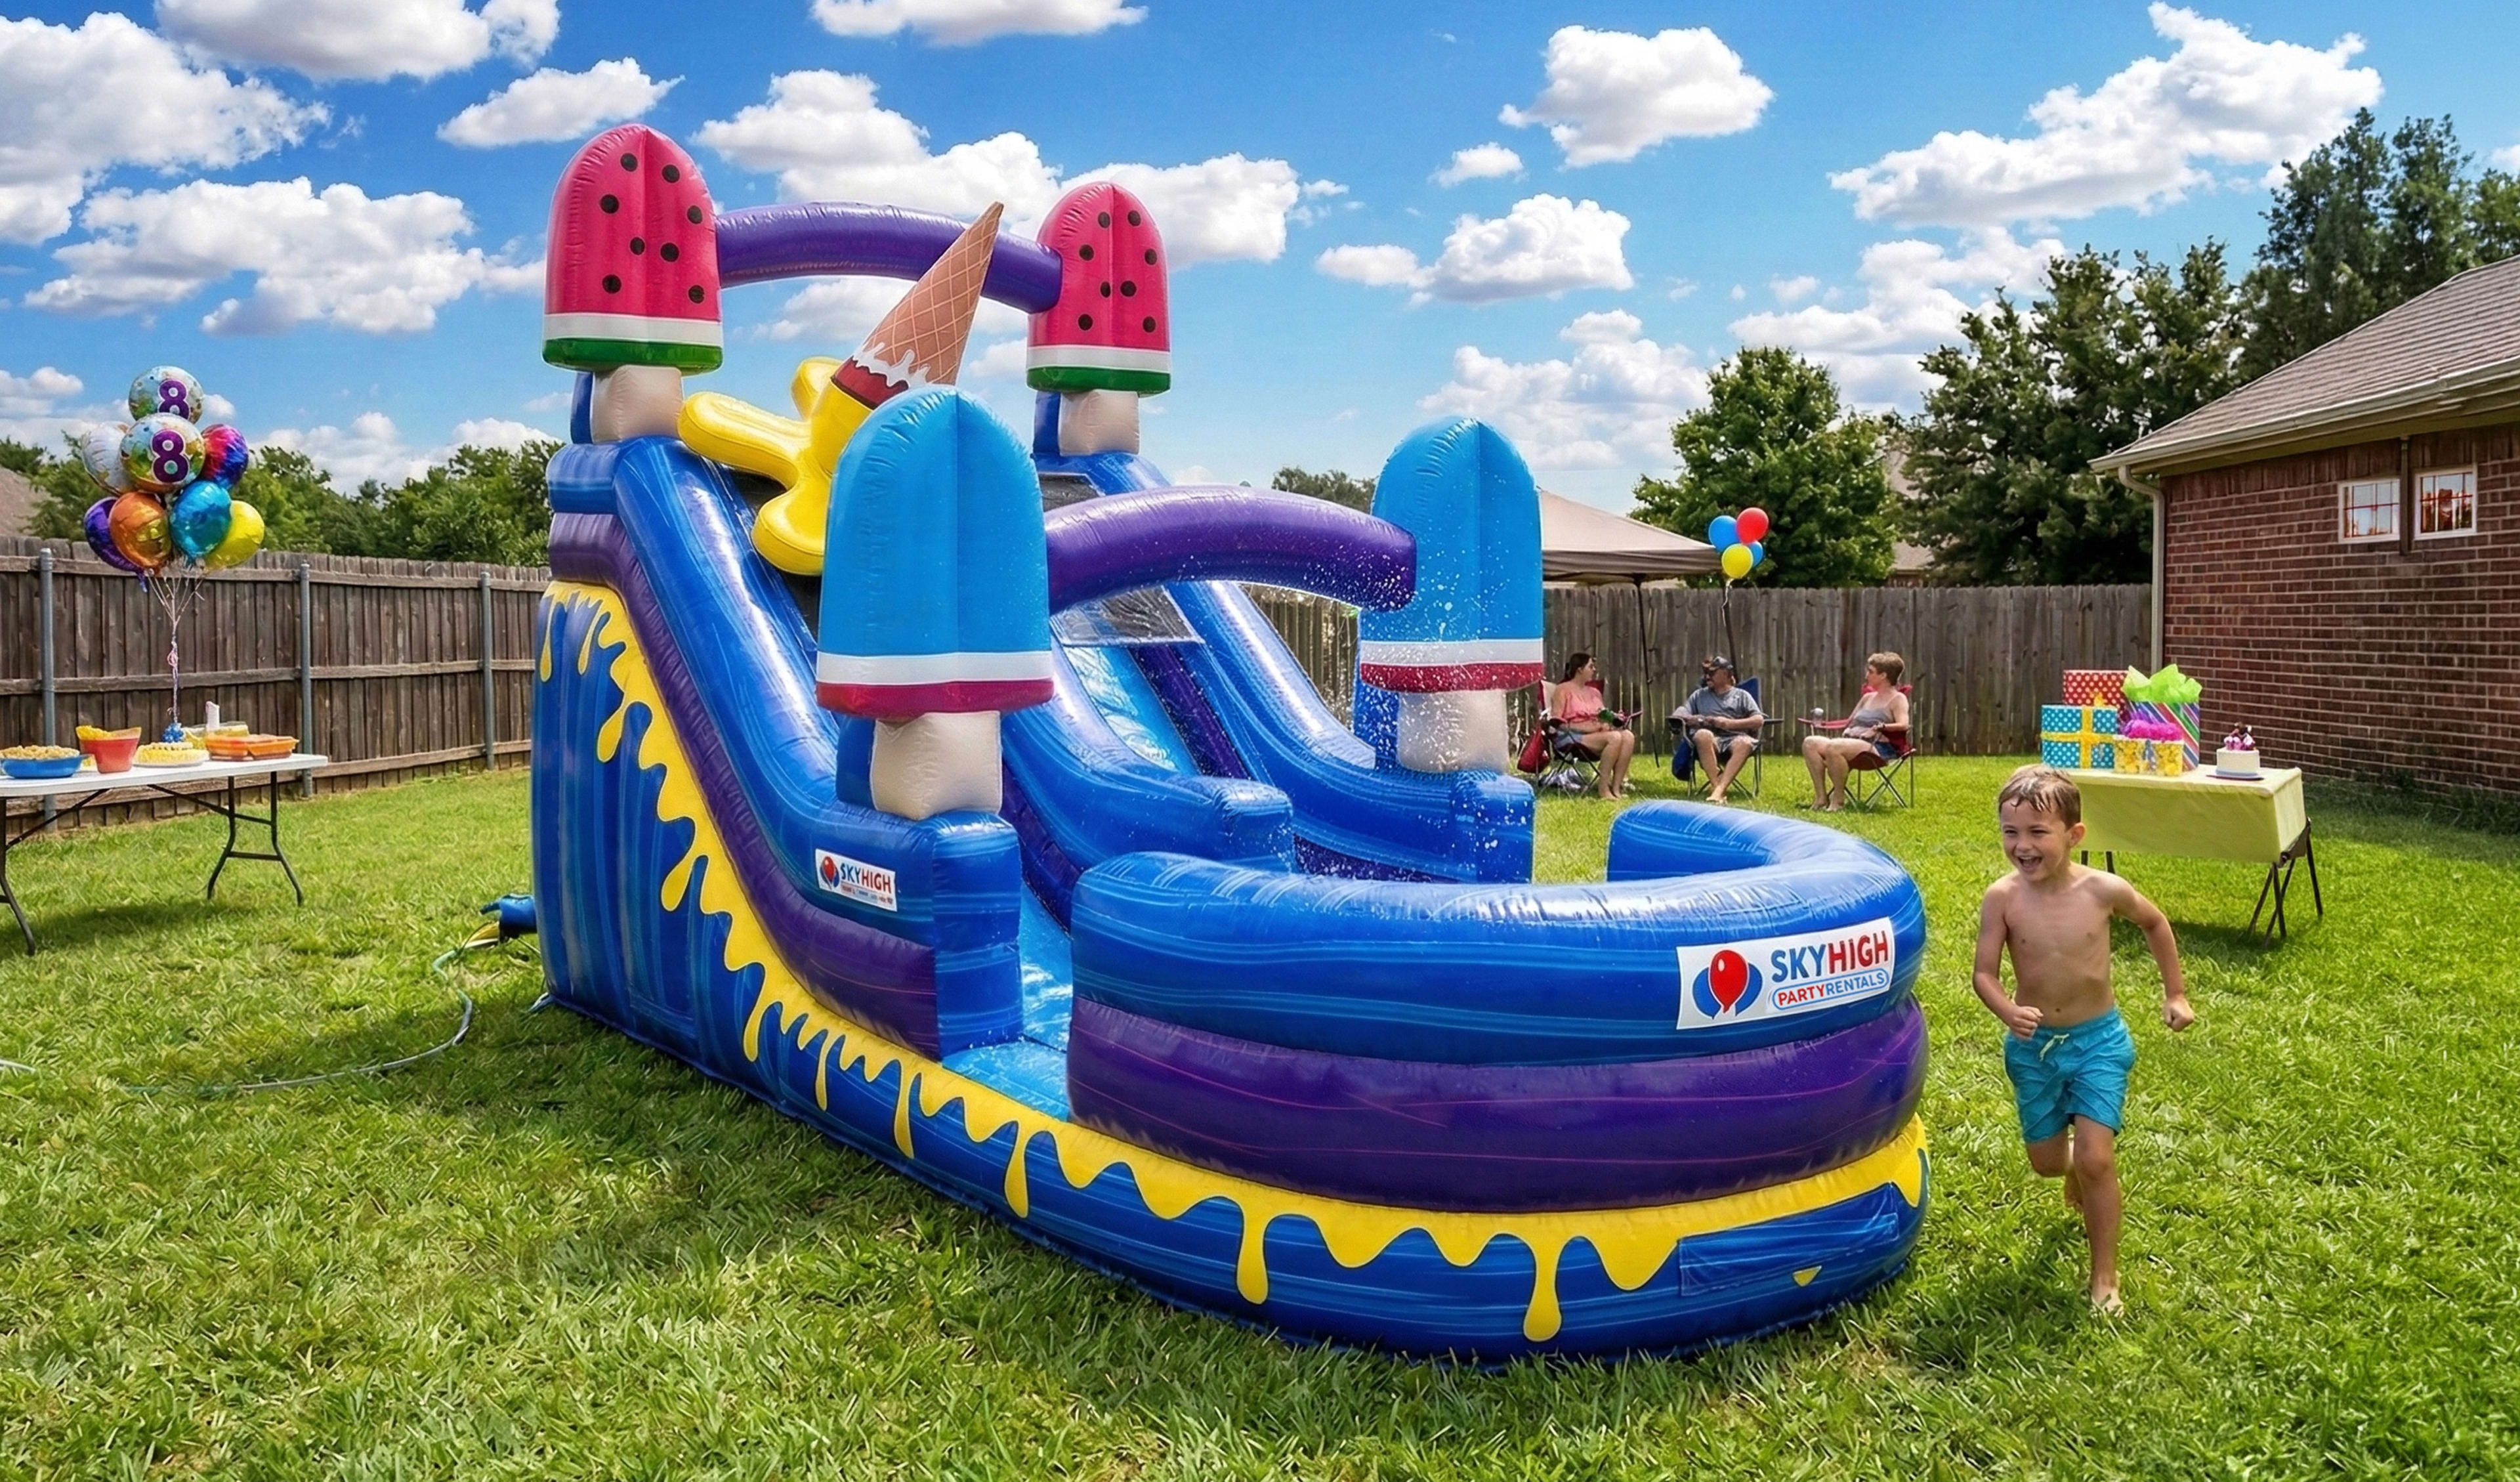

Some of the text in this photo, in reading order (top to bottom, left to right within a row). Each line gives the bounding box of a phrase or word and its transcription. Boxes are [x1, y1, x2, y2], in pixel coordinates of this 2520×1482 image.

[158, 379, 190, 420] 8
[151, 429, 190, 484] 8
[840, 862, 892, 895] SKYHIGH
[1771, 930, 1889, 983] SKYHIGH
